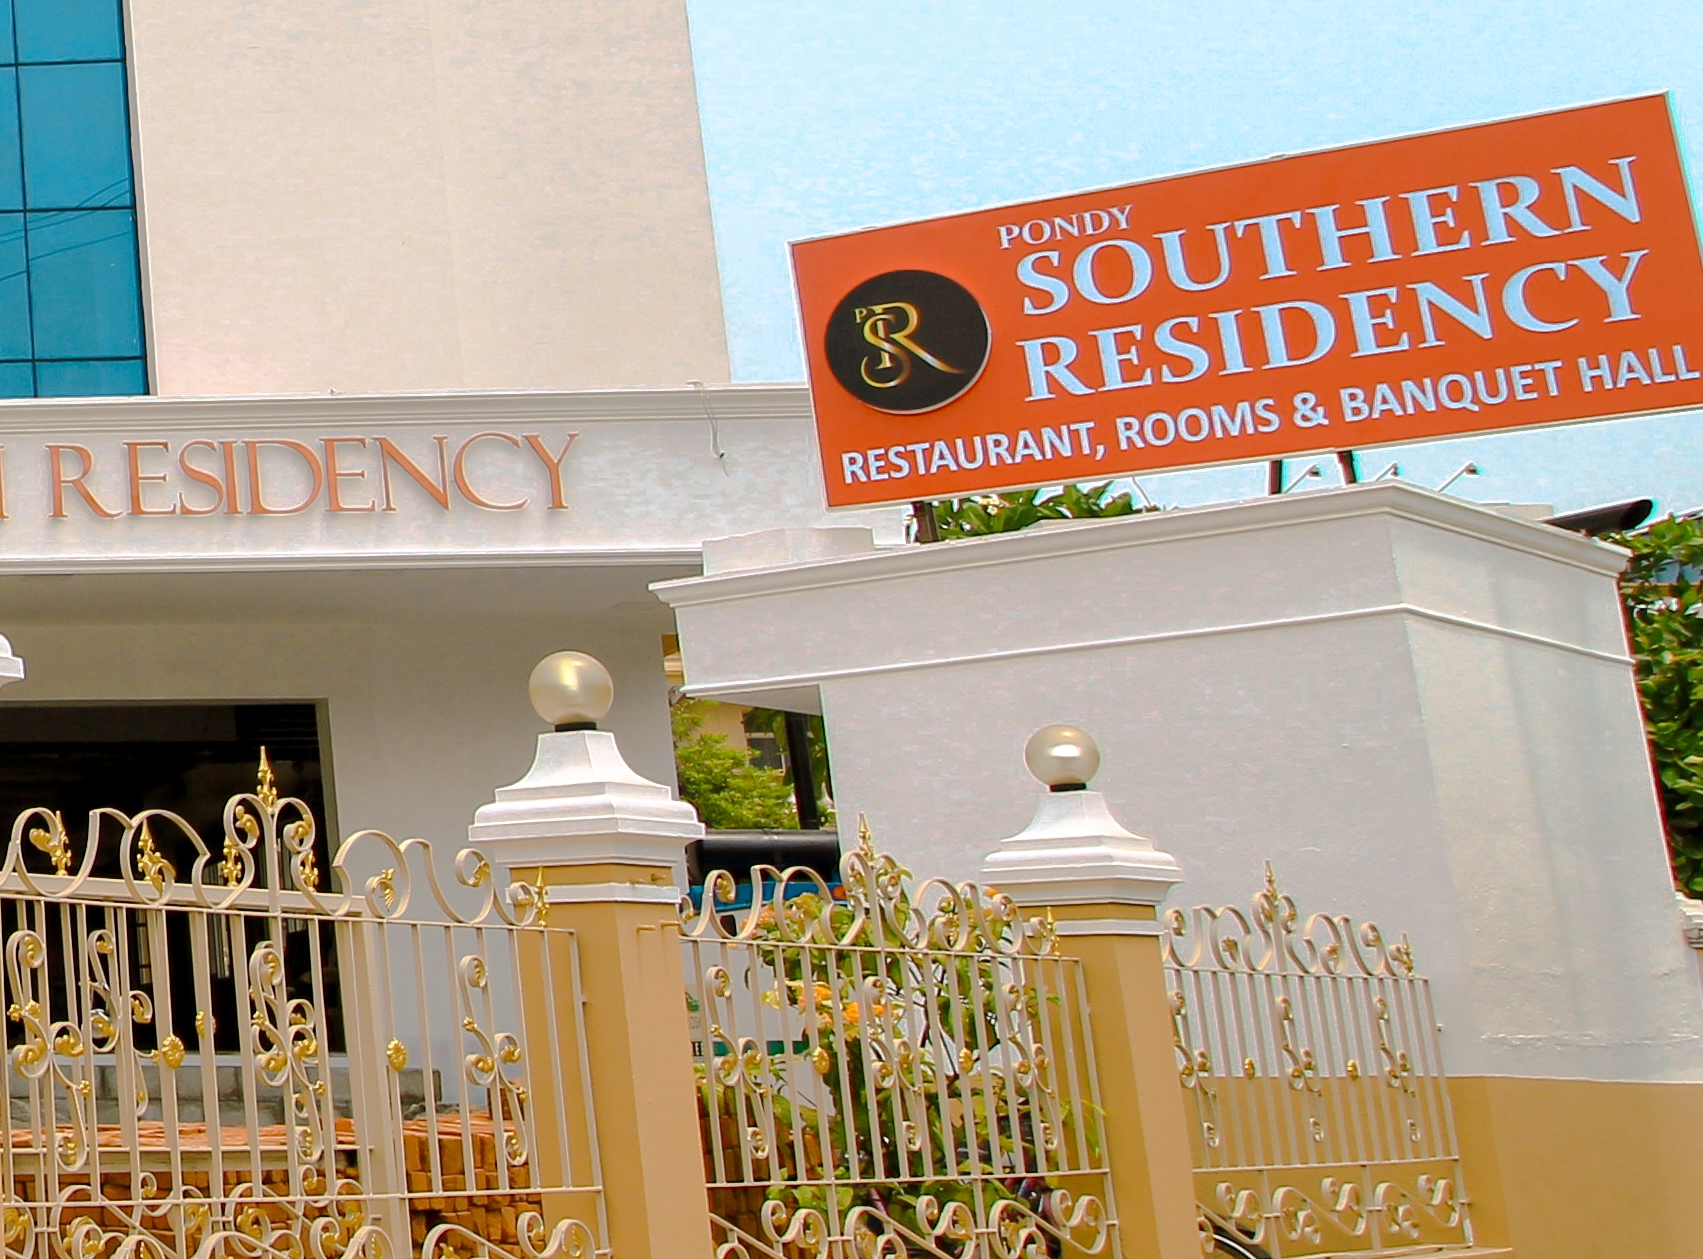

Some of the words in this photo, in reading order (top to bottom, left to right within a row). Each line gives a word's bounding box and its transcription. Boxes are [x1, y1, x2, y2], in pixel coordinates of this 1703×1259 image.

[997, 204, 1134, 249] PONDY
[1016, 155, 1643, 315] SOUTHERN
[1015, 249, 1650, 402] RESIDENCY
[46, 431, 581, 519] RESIDENCY
[841, 421, 1106, 484] RESTAURANT,
[1115, 398, 1281, 451] ROOMS
[1292, 391, 1330, 428] &
[1339, 360, 1564, 422] BANQUET
[1577, 344, 1702, 393] HALL
